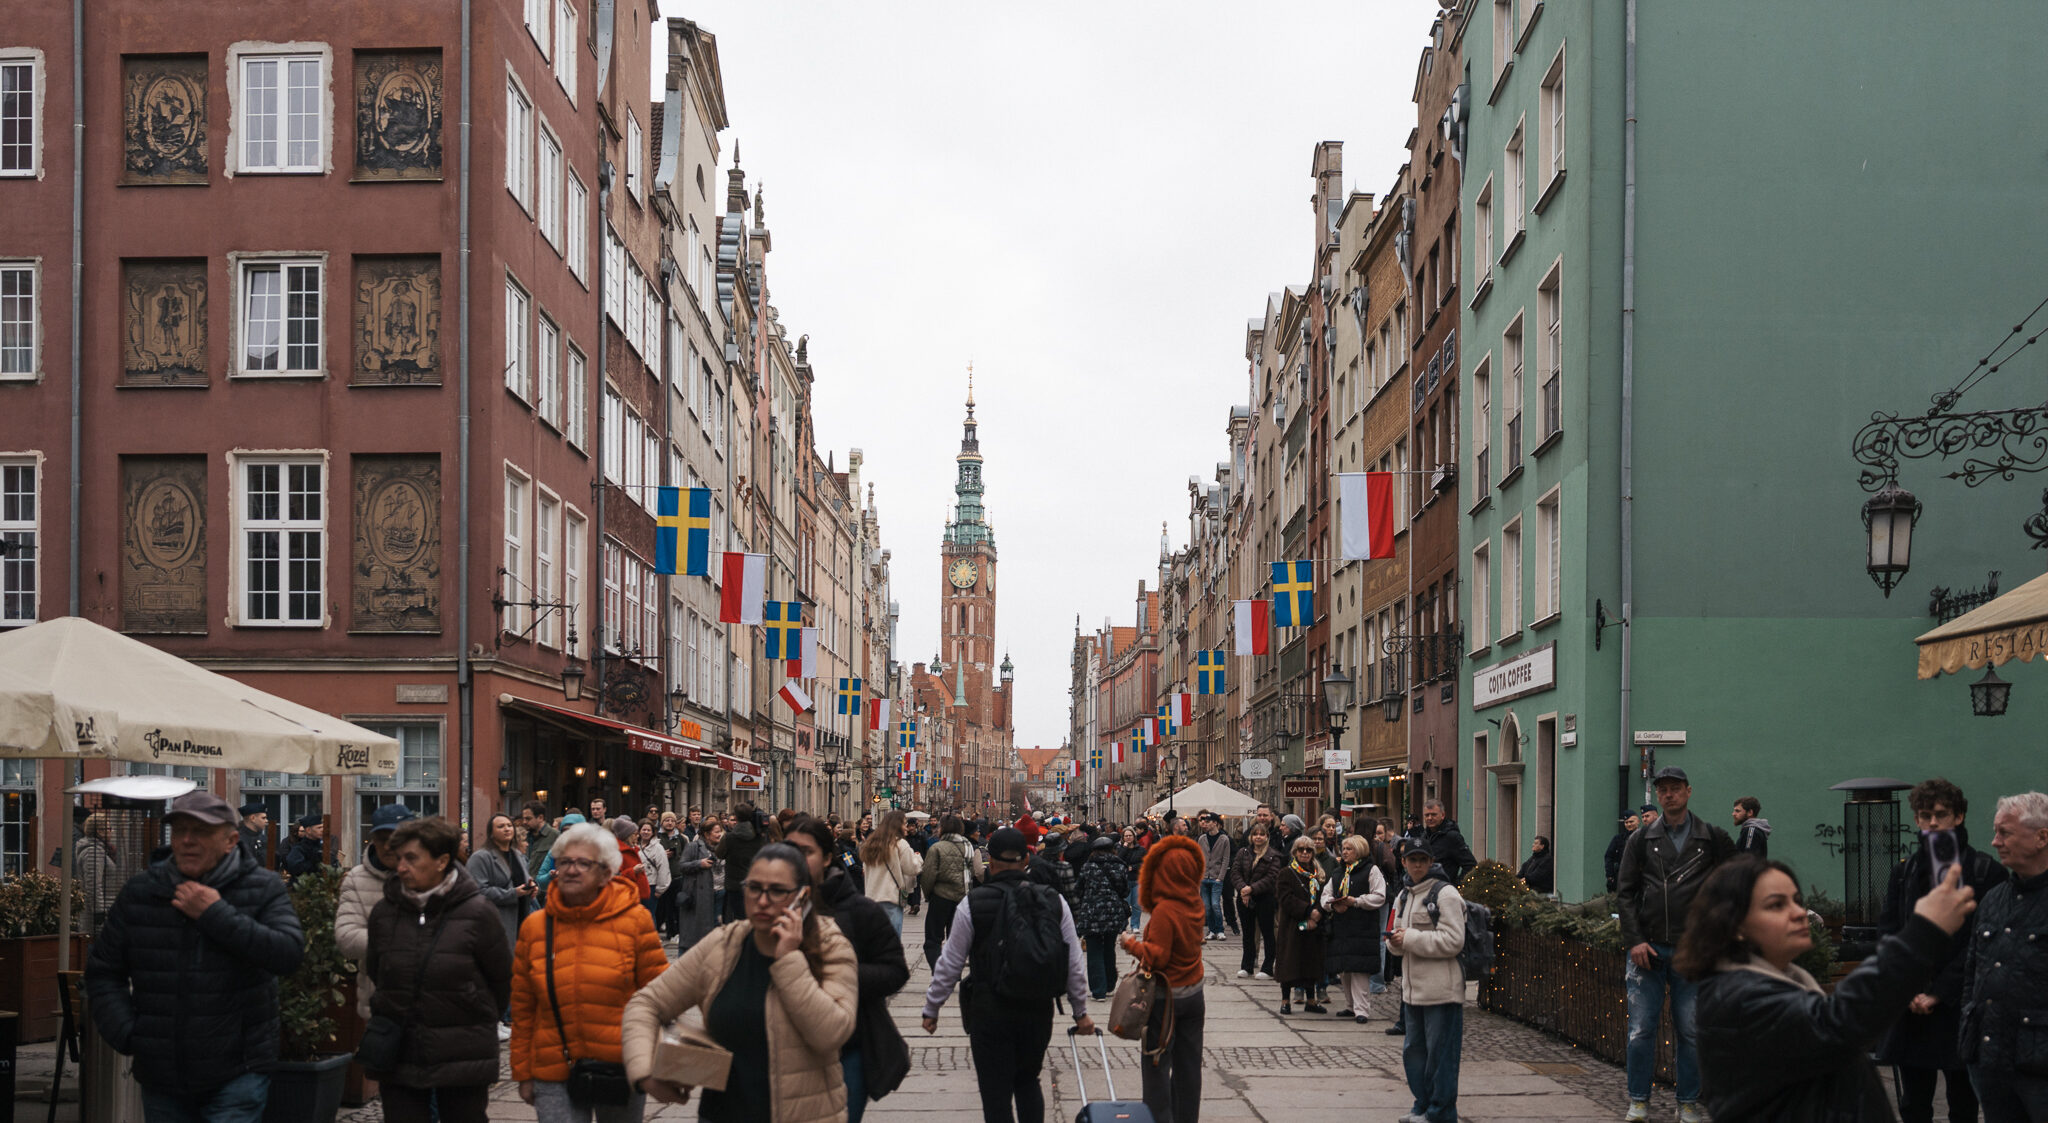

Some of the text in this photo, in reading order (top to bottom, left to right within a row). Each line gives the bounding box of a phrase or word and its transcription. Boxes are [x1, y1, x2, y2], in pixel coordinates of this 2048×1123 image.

[1488, 662, 1532, 694] COSTA COFFEE
[160, 738, 223, 756] PAN PAPUGA
[336, 744, 370, 769] Kozel
